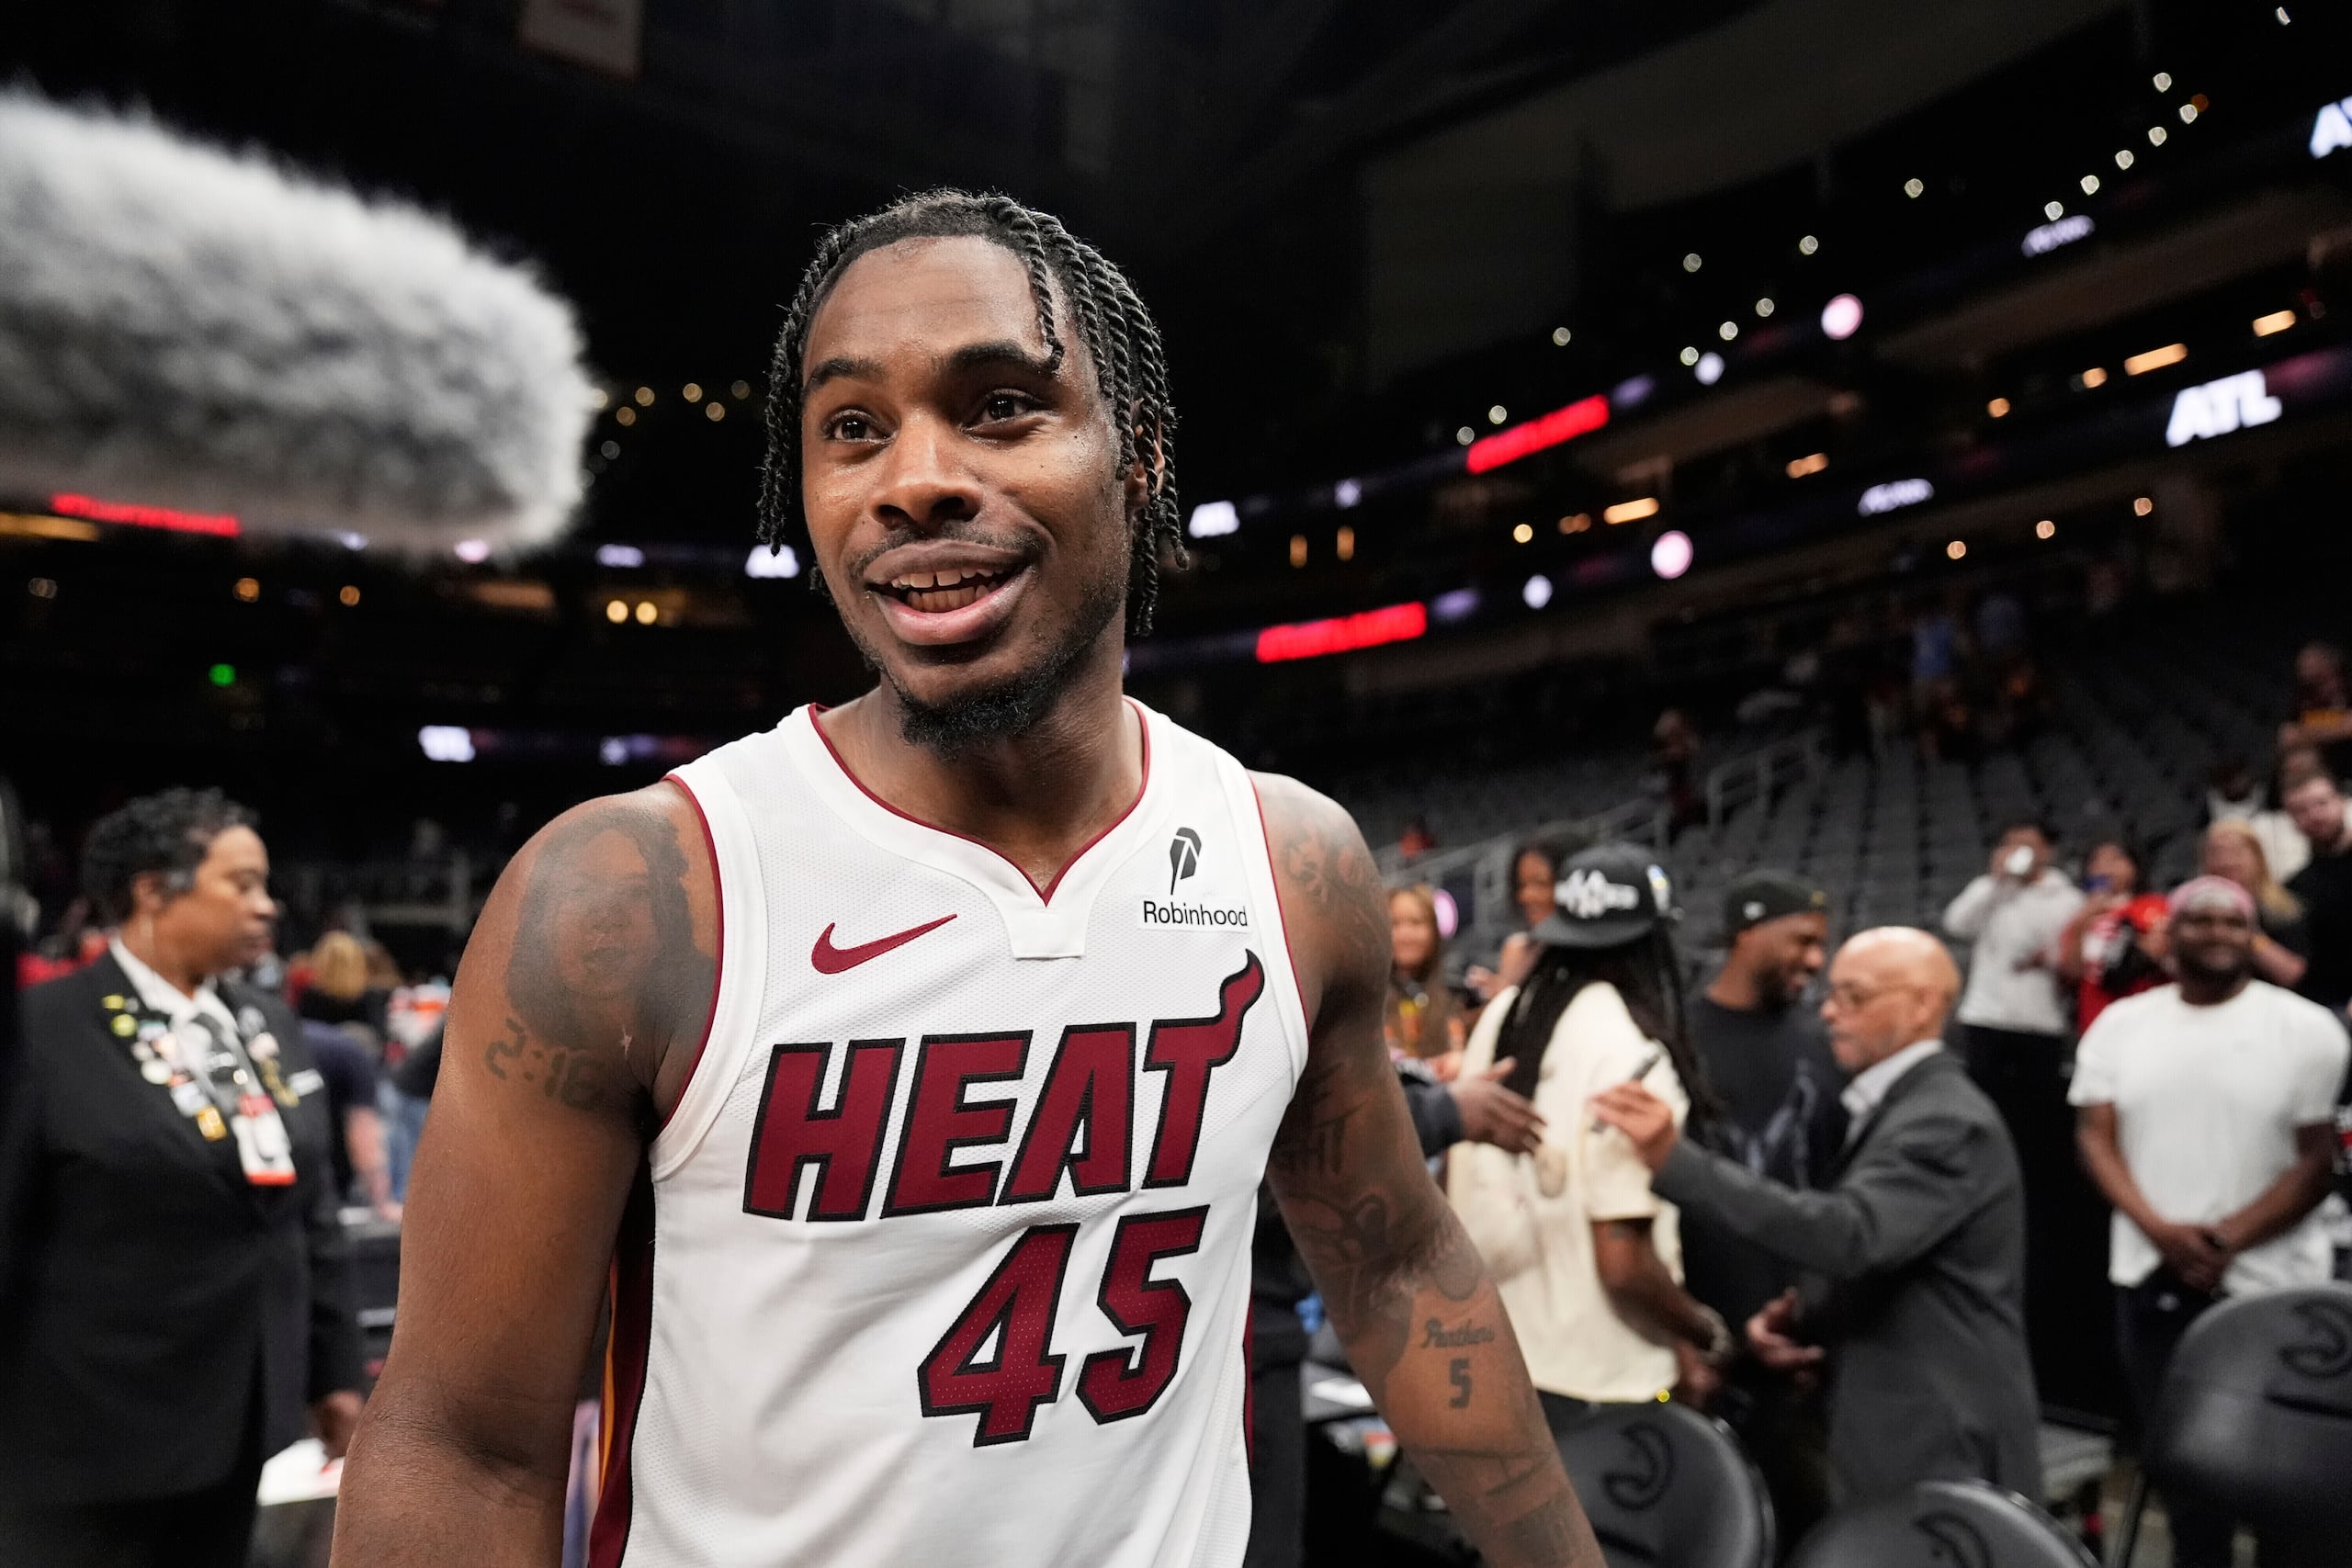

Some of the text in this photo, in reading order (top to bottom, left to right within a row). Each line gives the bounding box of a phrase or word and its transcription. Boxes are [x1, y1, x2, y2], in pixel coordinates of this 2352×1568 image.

[2309, 95, 2352, 159] A
[2166, 368, 2282, 446] ATL
[1143, 900, 1248, 927] Robinhood
[742, 948, 1265, 1223] HEAT
[918, 1204, 1210, 1449] 45
[1449, 1358, 1473, 1409] 5
